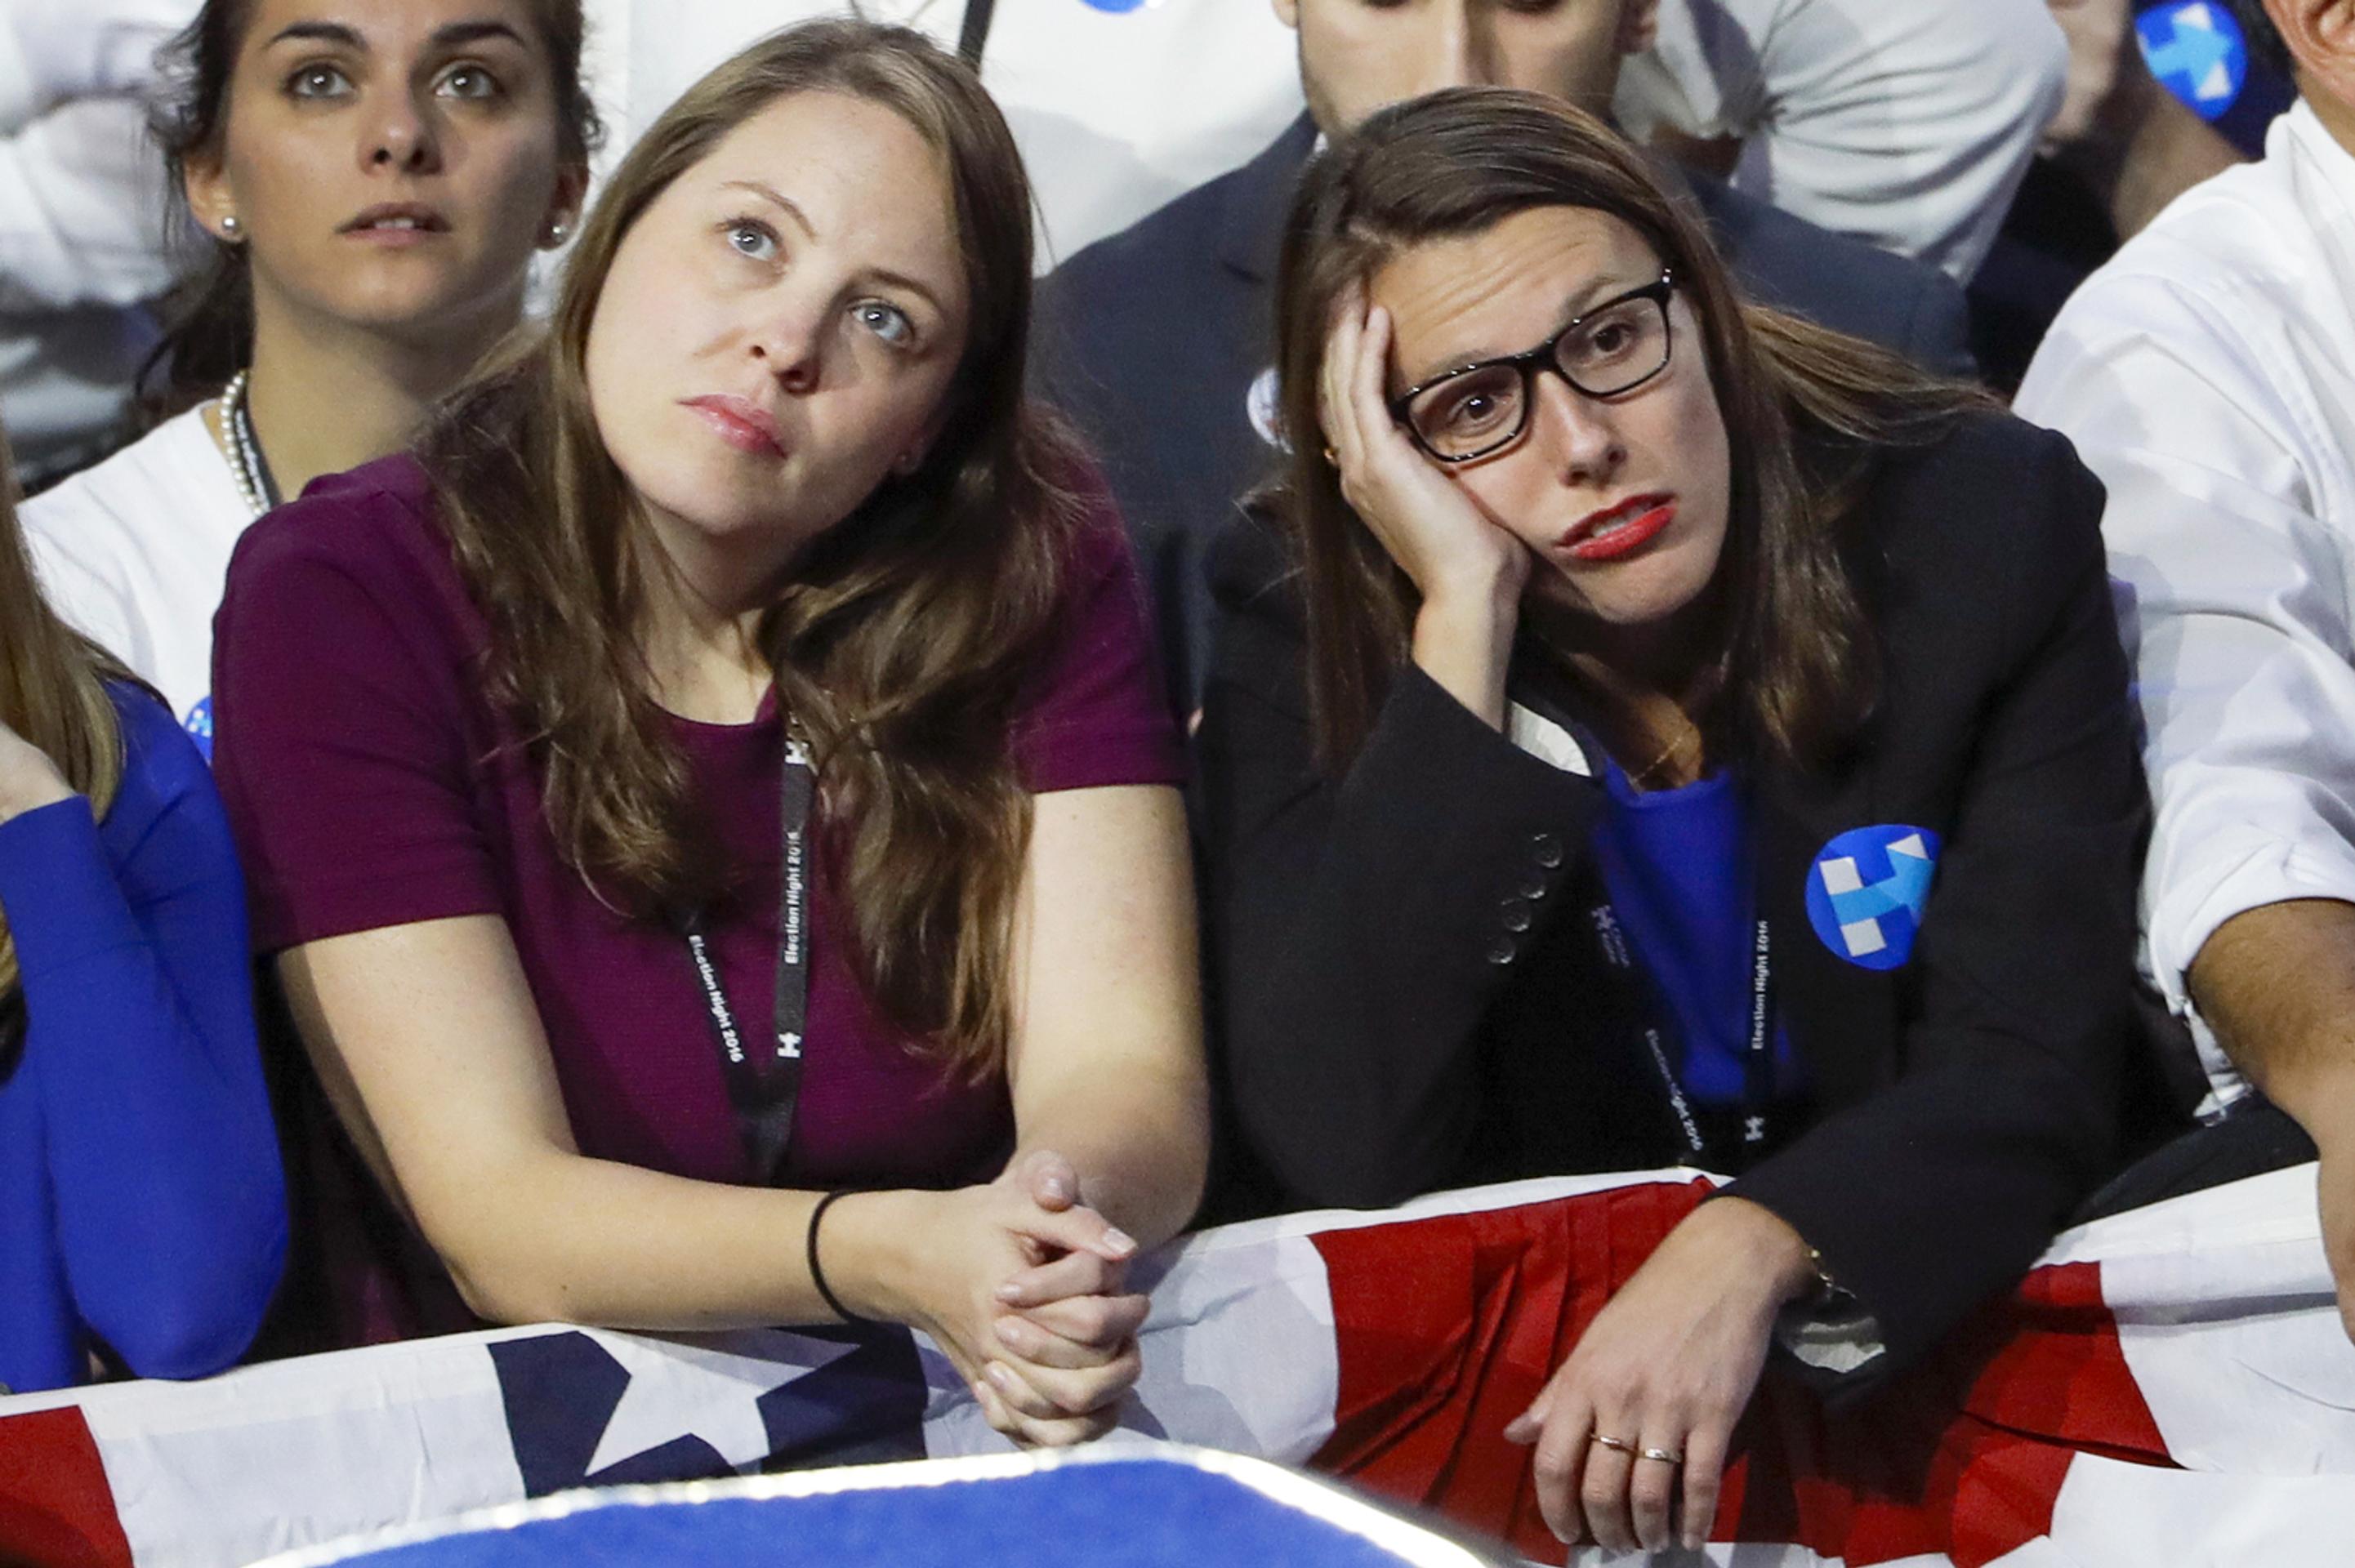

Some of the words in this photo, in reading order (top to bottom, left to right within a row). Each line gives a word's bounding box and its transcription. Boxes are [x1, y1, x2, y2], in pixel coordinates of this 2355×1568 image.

[786, 866, 804, 906] Night
[784, 906, 800, 964] Election
[1756, 920, 1769, 952] 2016
[1754, 955, 1770, 992] Night
[689, 935, 717, 991] Election
[708, 991, 732, 1029] Night
[722, 1029, 745, 1062] 2016
[1751, 993, 1765, 1049] Election
